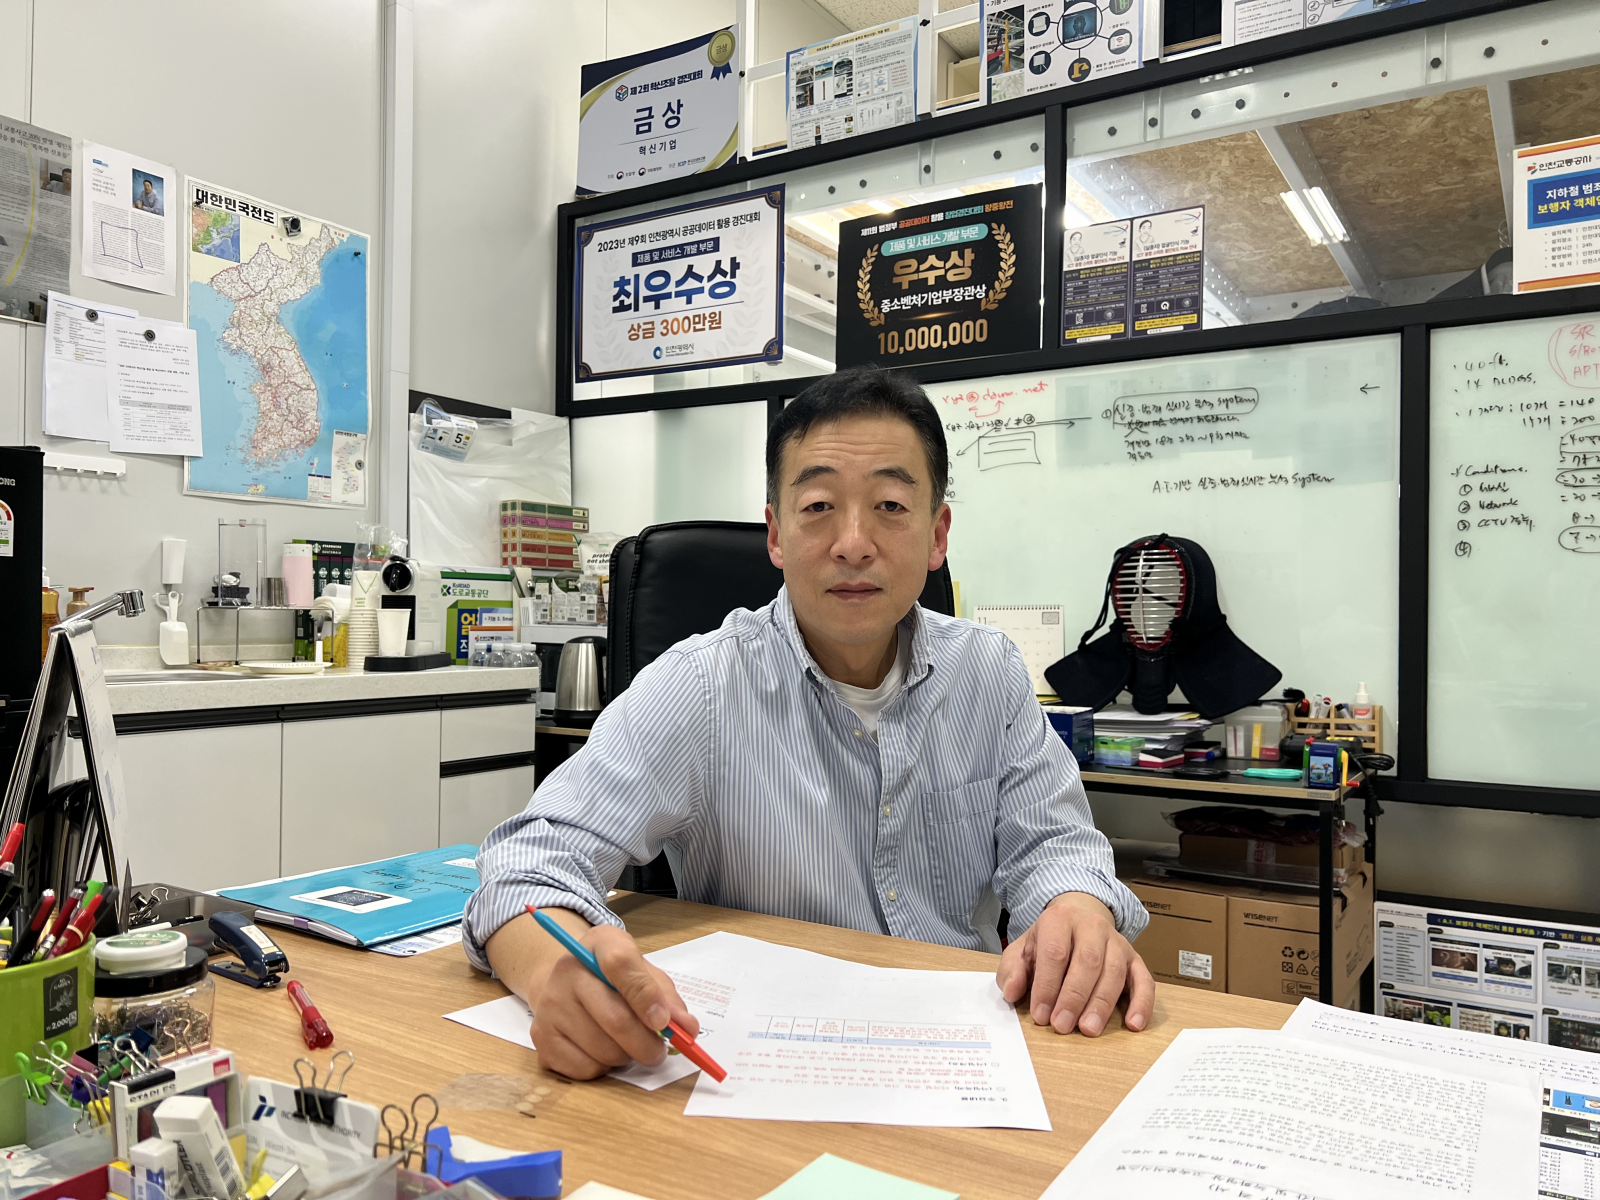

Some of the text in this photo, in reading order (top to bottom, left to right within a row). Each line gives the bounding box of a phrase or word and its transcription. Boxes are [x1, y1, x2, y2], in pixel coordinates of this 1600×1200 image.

[638, 139, 676, 155] 혁신기업
[1539, 155, 1592, 171] 인천교통공사
[1546, 186, 1579, 199] 지하철
[196, 188, 274, 224] 대한민국전도
[1537, 200, 1570, 214] 보행자
[597, 211, 760, 252] 2023년 제9회 인천광역시 공공데이터 활용 경진대회
[890, 227, 979, 252] 제품 및 서비스 개발 부문
[637, 240, 714, 264] 제품 및 서비스 개발 부문
[892, 248, 975, 289] 우수상
[612, 256, 740, 314] 최우수상
[881, 284, 987, 313] 중소벤처기업부장관상
[628, 310, 722, 341] 상금 300만원
[878, 319, 988, 355] 10,000,000
[665, 343, 694, 354] 인천광역시
[1022, 381, 1049, 392] net
[454, 433, 463, 444] 5
[452, 588, 489, 598] 도로교통공단
